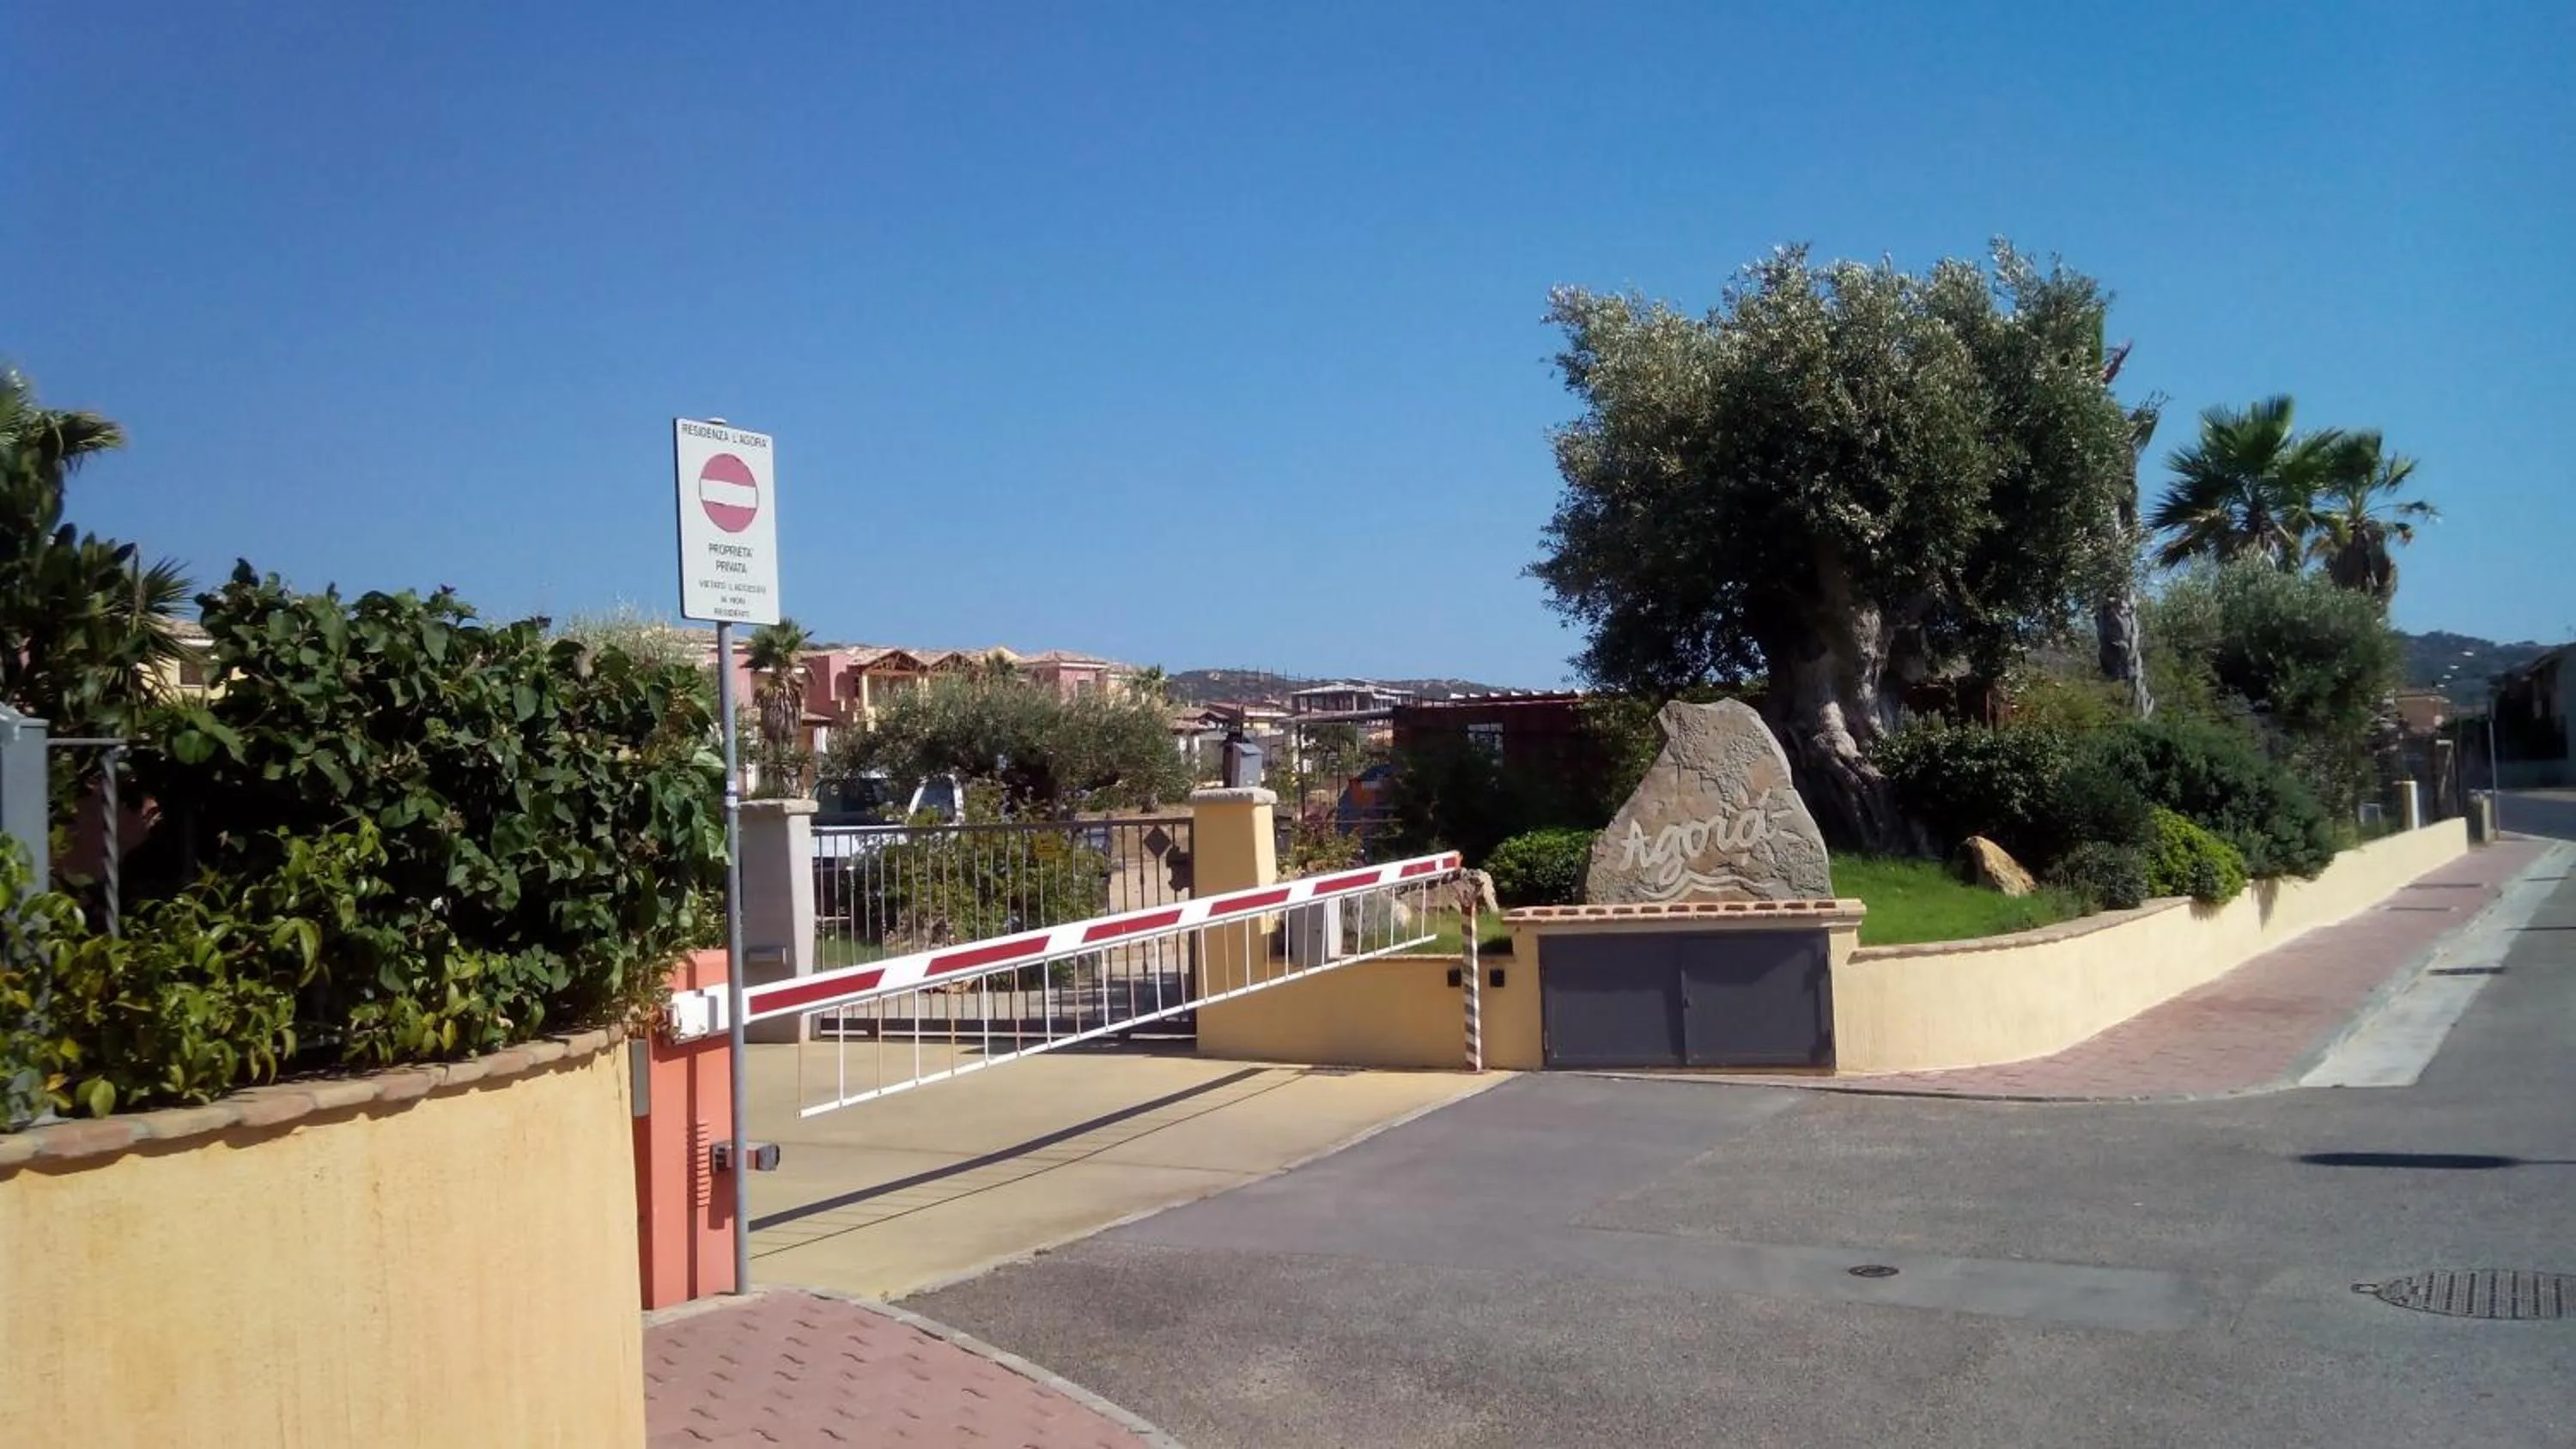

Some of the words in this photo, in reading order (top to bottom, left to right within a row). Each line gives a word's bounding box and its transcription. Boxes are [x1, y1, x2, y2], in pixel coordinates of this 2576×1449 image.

[681, 424, 729, 440] RESIDENZA
[715, 560, 747, 573] PRIVATA
[699, 579, 726, 589] VIETATO
